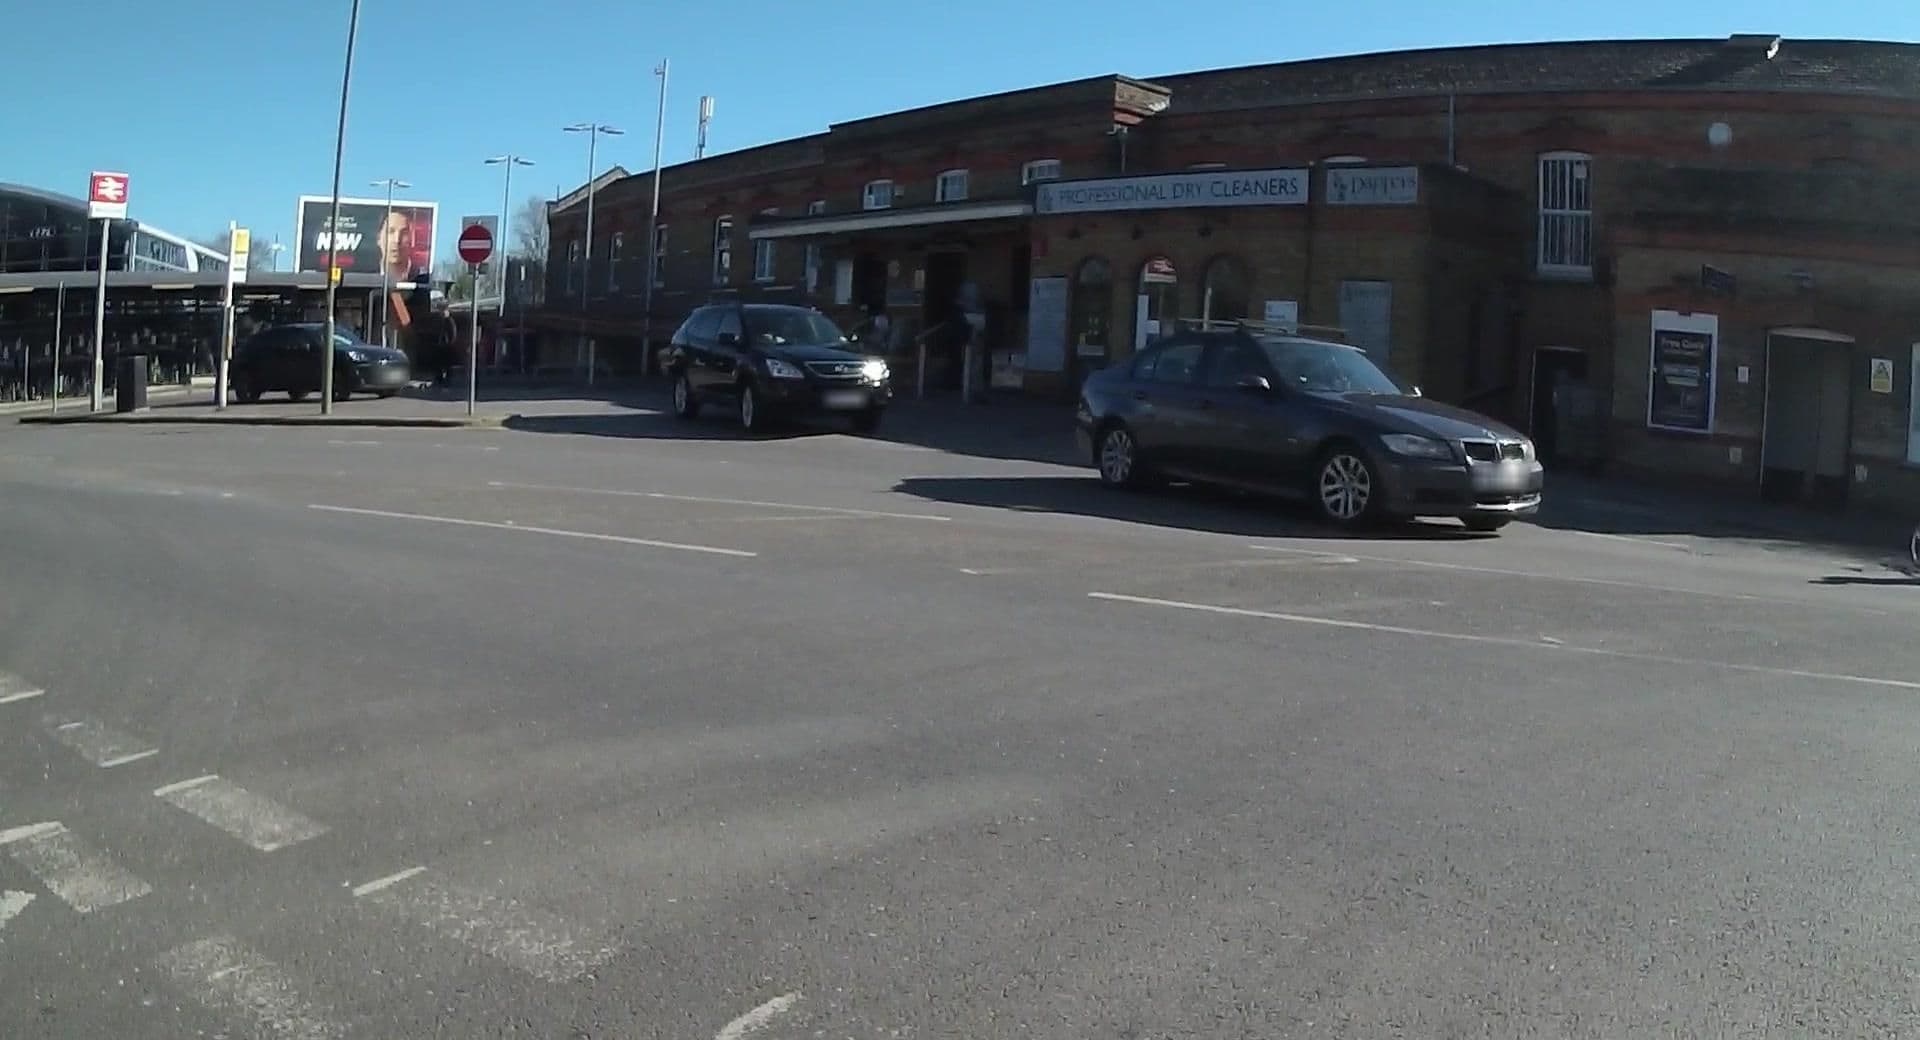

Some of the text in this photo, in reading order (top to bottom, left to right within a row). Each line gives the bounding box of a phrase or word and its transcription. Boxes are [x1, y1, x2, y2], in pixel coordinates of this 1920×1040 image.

[1059, 177, 1298, 204] PROFESSIONAL DRY CLEANERS
[316, 232, 363, 251] NOW
